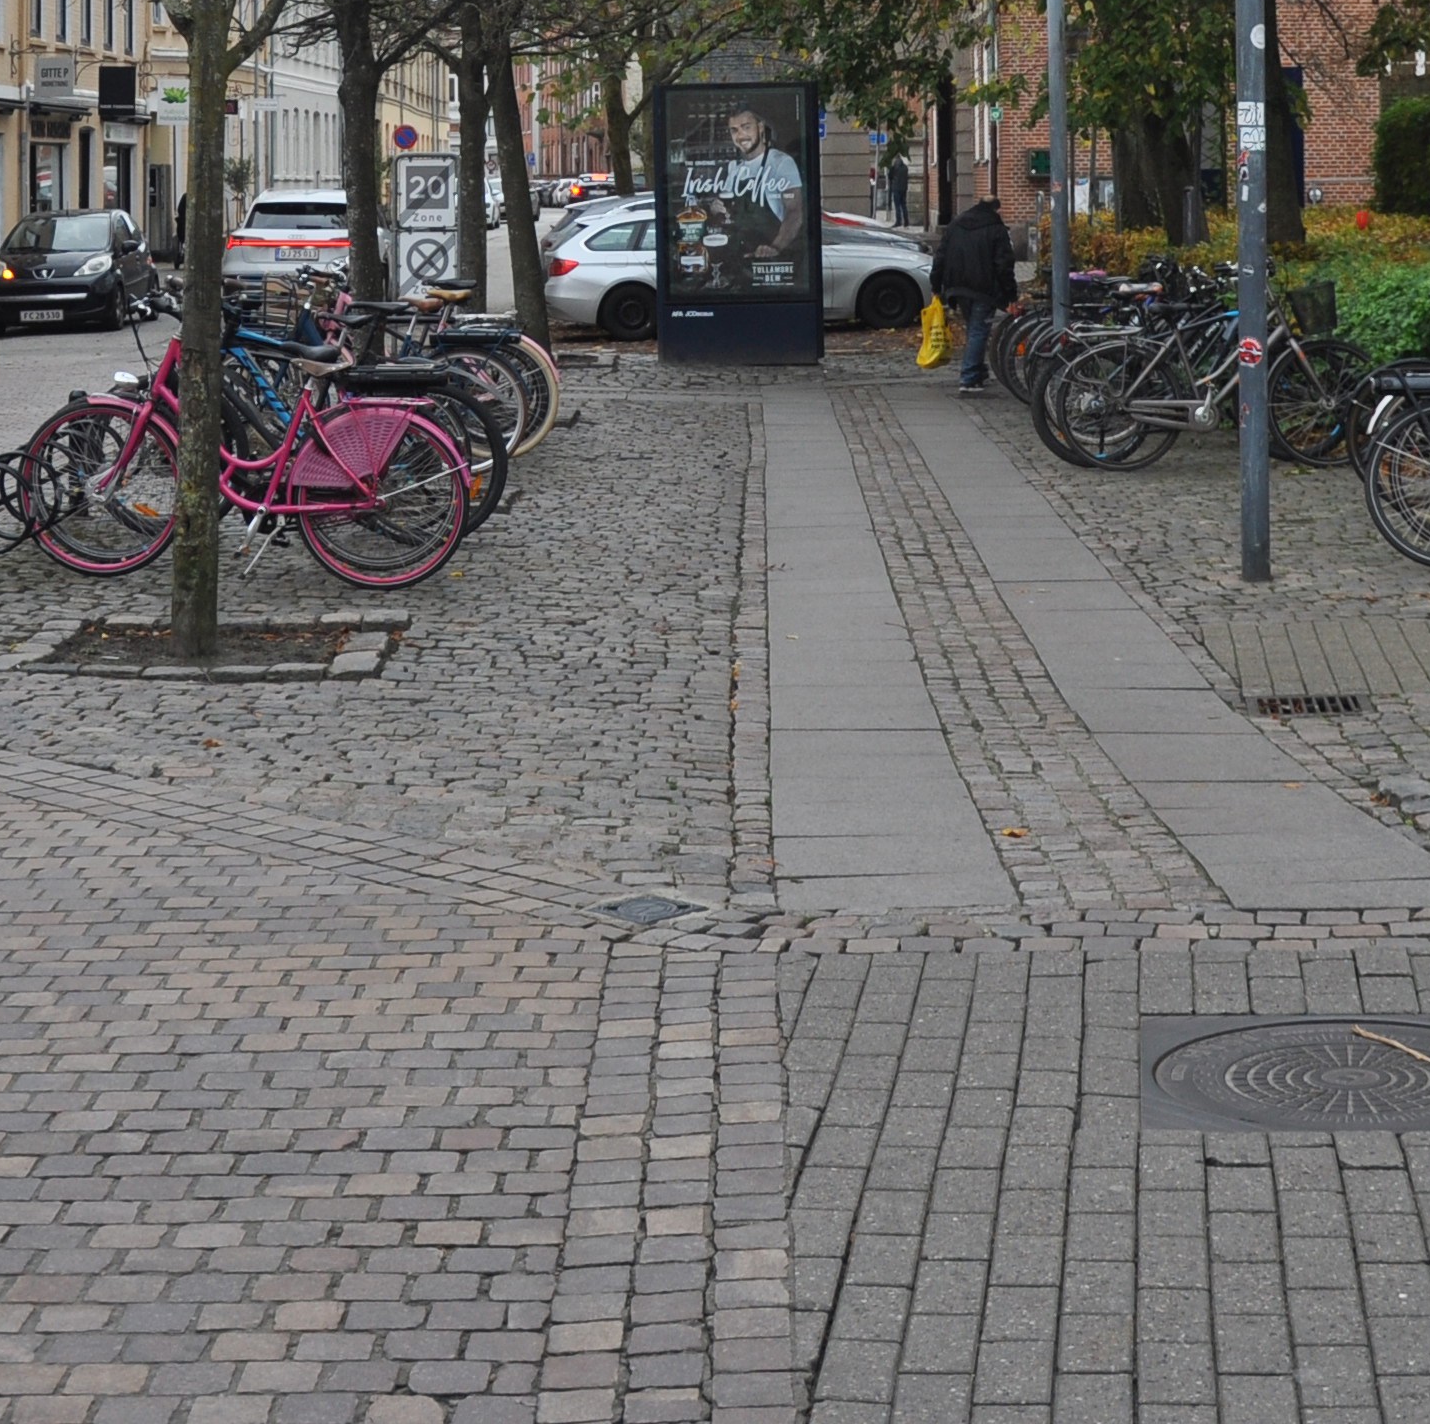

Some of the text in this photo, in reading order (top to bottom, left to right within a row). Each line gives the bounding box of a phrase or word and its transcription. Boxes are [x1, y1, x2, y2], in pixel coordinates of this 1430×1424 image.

[41, 68, 61, 78] GITTE
[409, 176, 445, 200] 20
[681, 166, 791, 207] Irish Coffee
[412, 213, 443, 222] Zone
